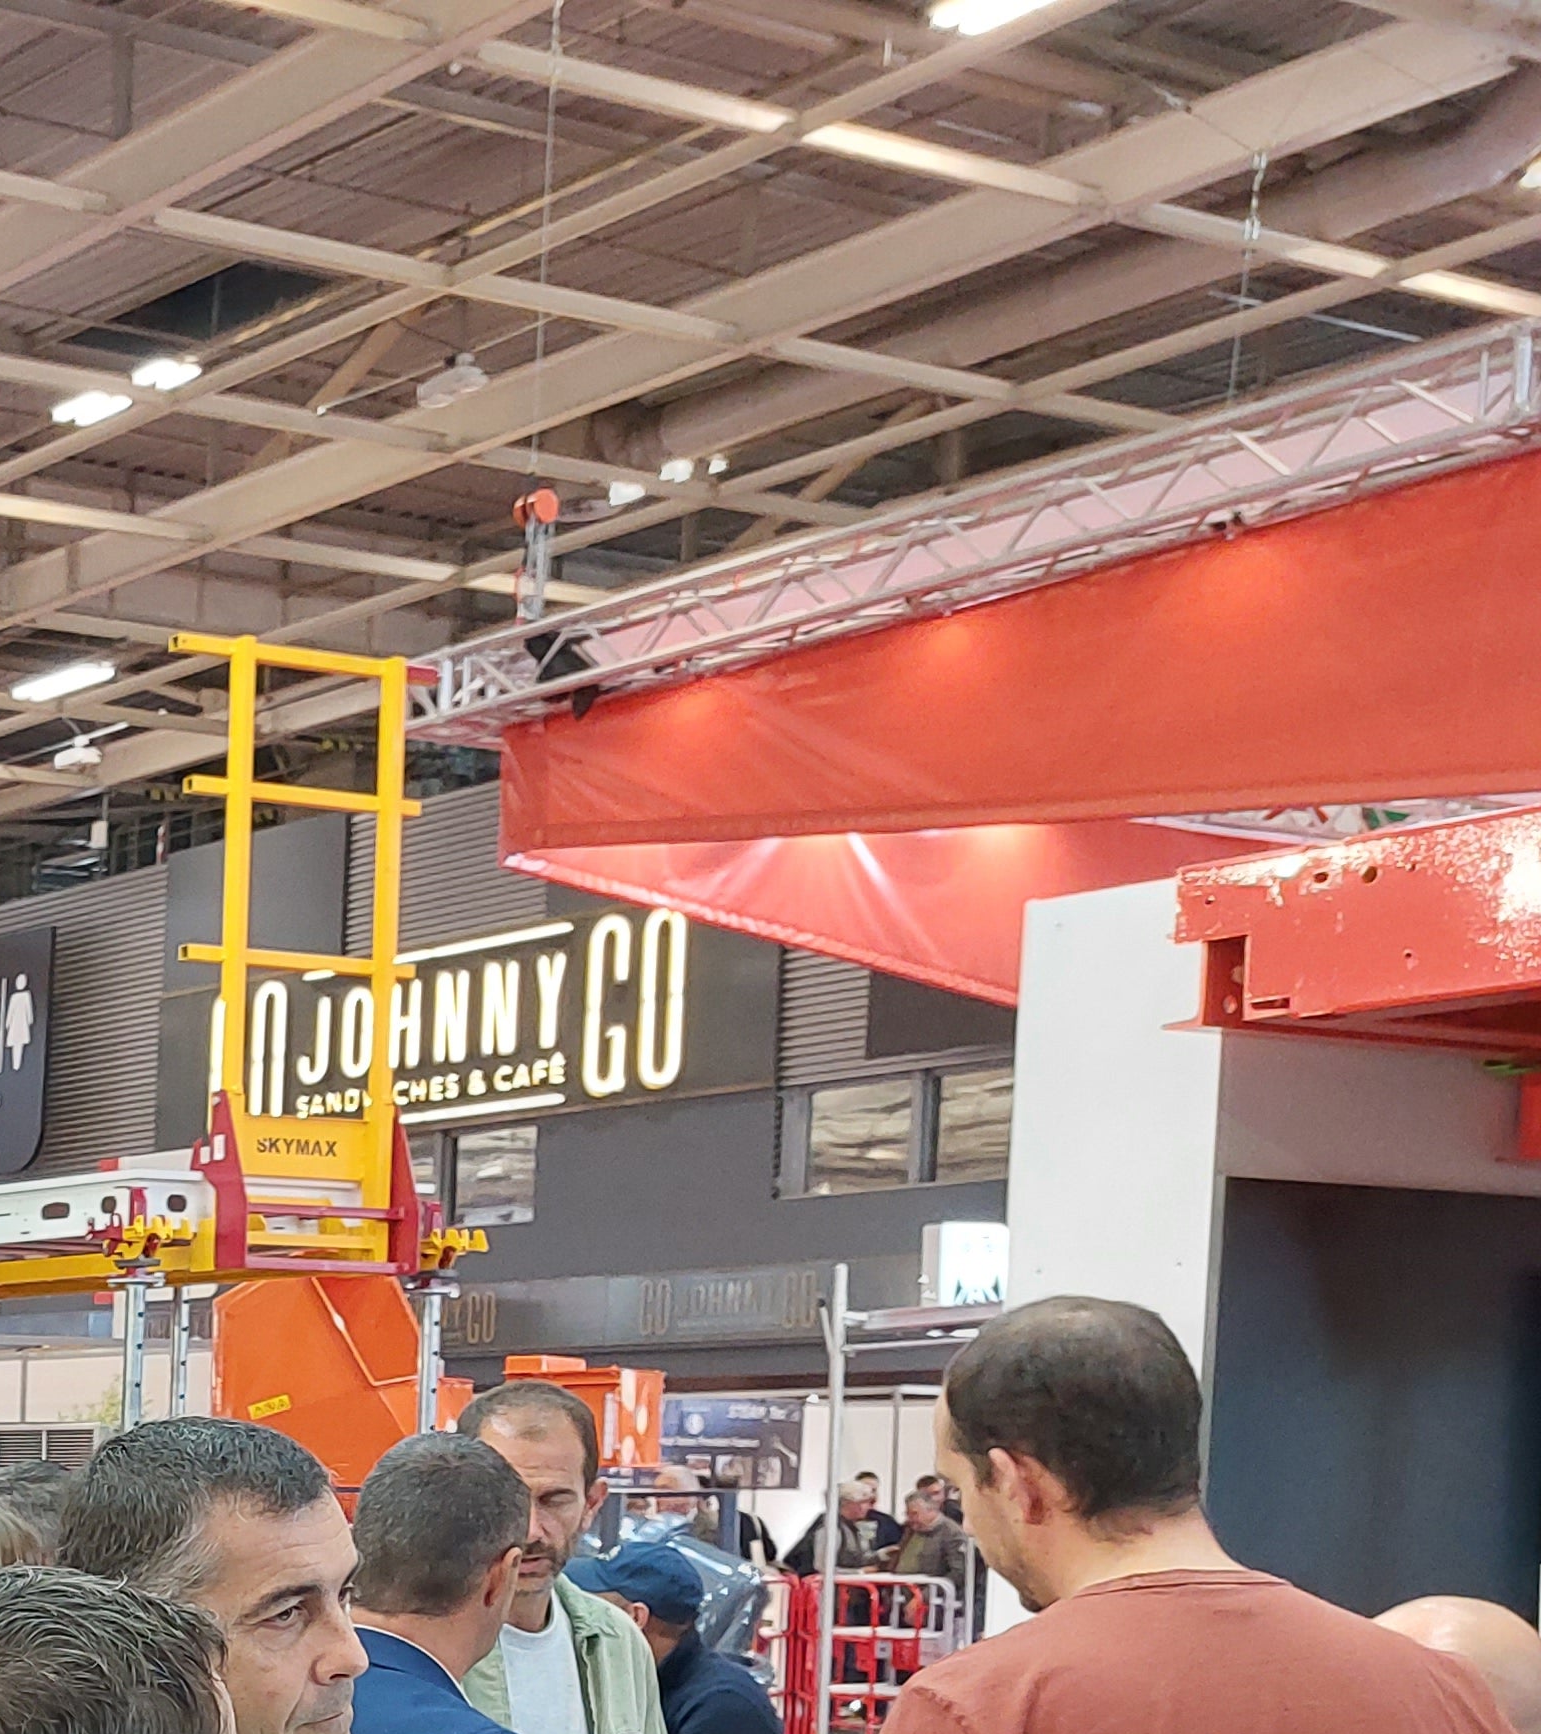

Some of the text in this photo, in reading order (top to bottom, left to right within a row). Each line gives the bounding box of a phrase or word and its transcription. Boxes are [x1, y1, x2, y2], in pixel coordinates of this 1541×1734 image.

[295, 951, 567, 1086] JOHNNY
[581, 907, 687, 1098] GO
[295, 1050, 566, 1119] SANDCHES & CAFÉ
[256, 1137, 338, 1158] SKYMAX
